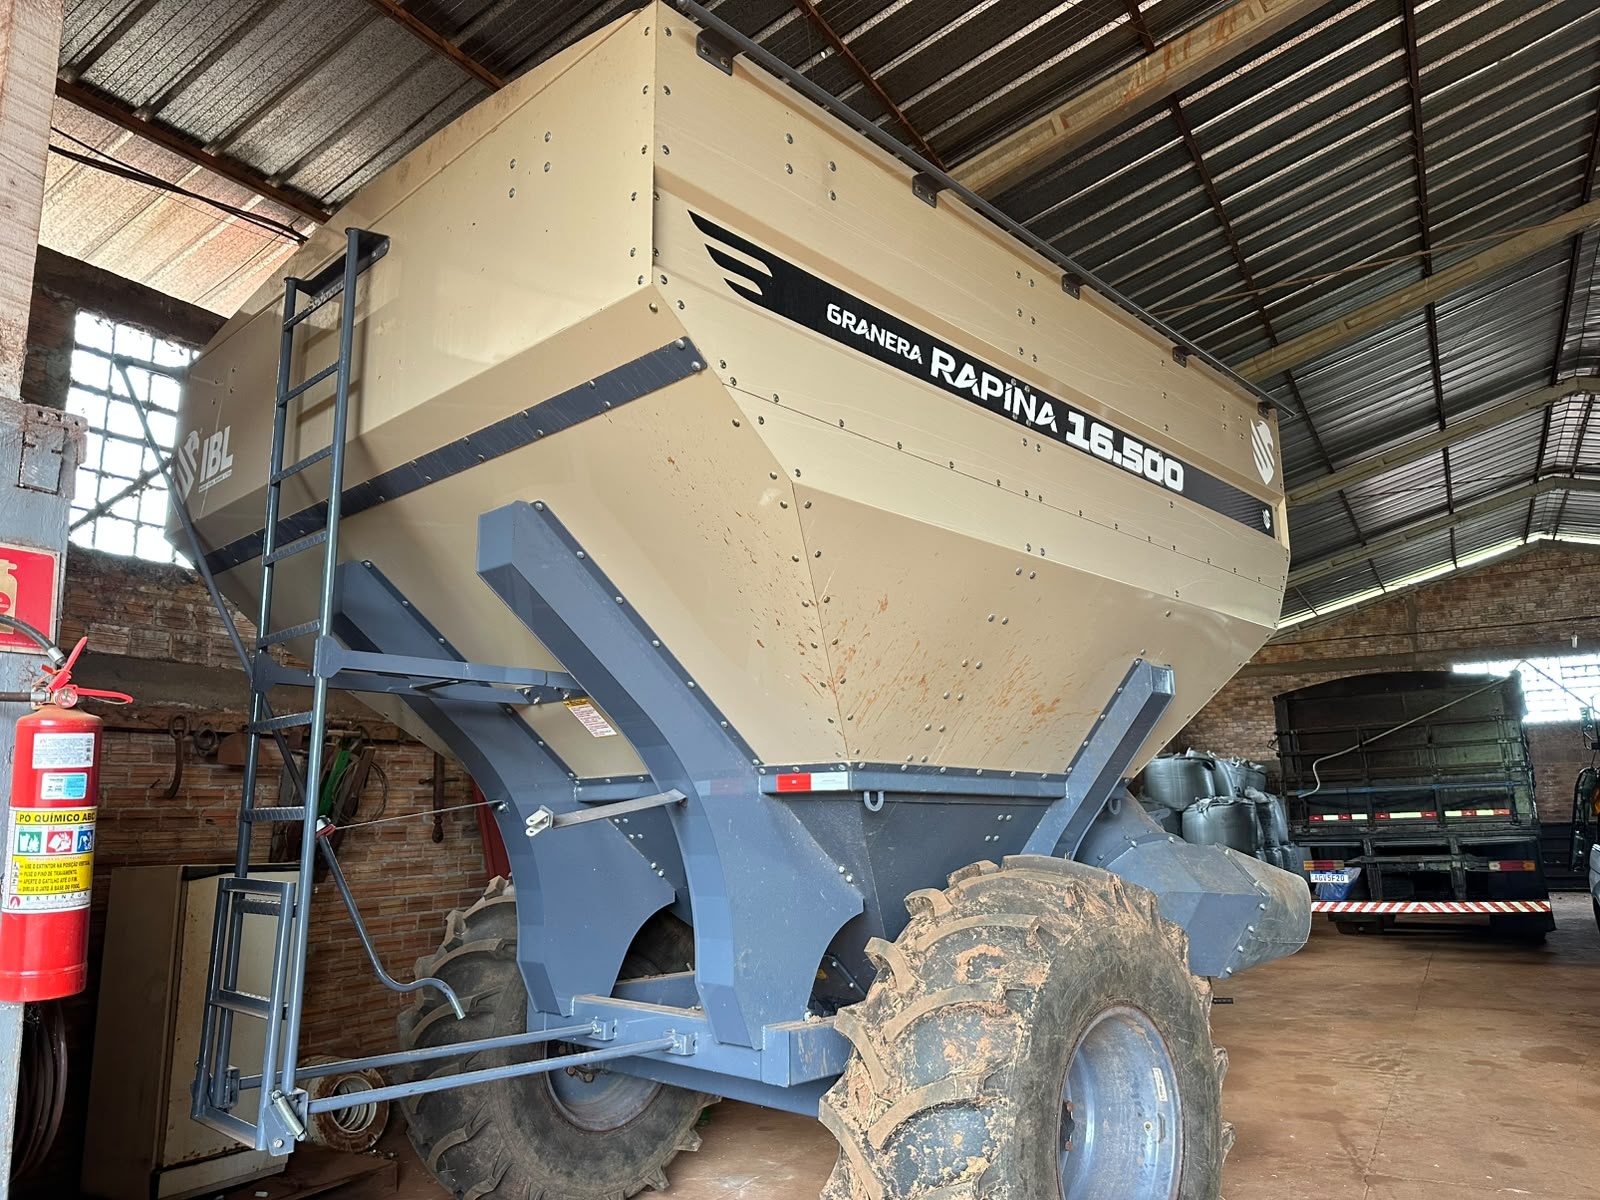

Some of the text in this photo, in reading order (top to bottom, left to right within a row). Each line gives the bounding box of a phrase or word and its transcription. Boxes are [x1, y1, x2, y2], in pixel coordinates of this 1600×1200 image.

[826, 303, 1184, 492] GRANERA RAPINA 16.500
[200, 425, 233, 483] IBL
[19, 813, 31, 822] PÓ
[34, 812, 80, 822] QUÍMICO
